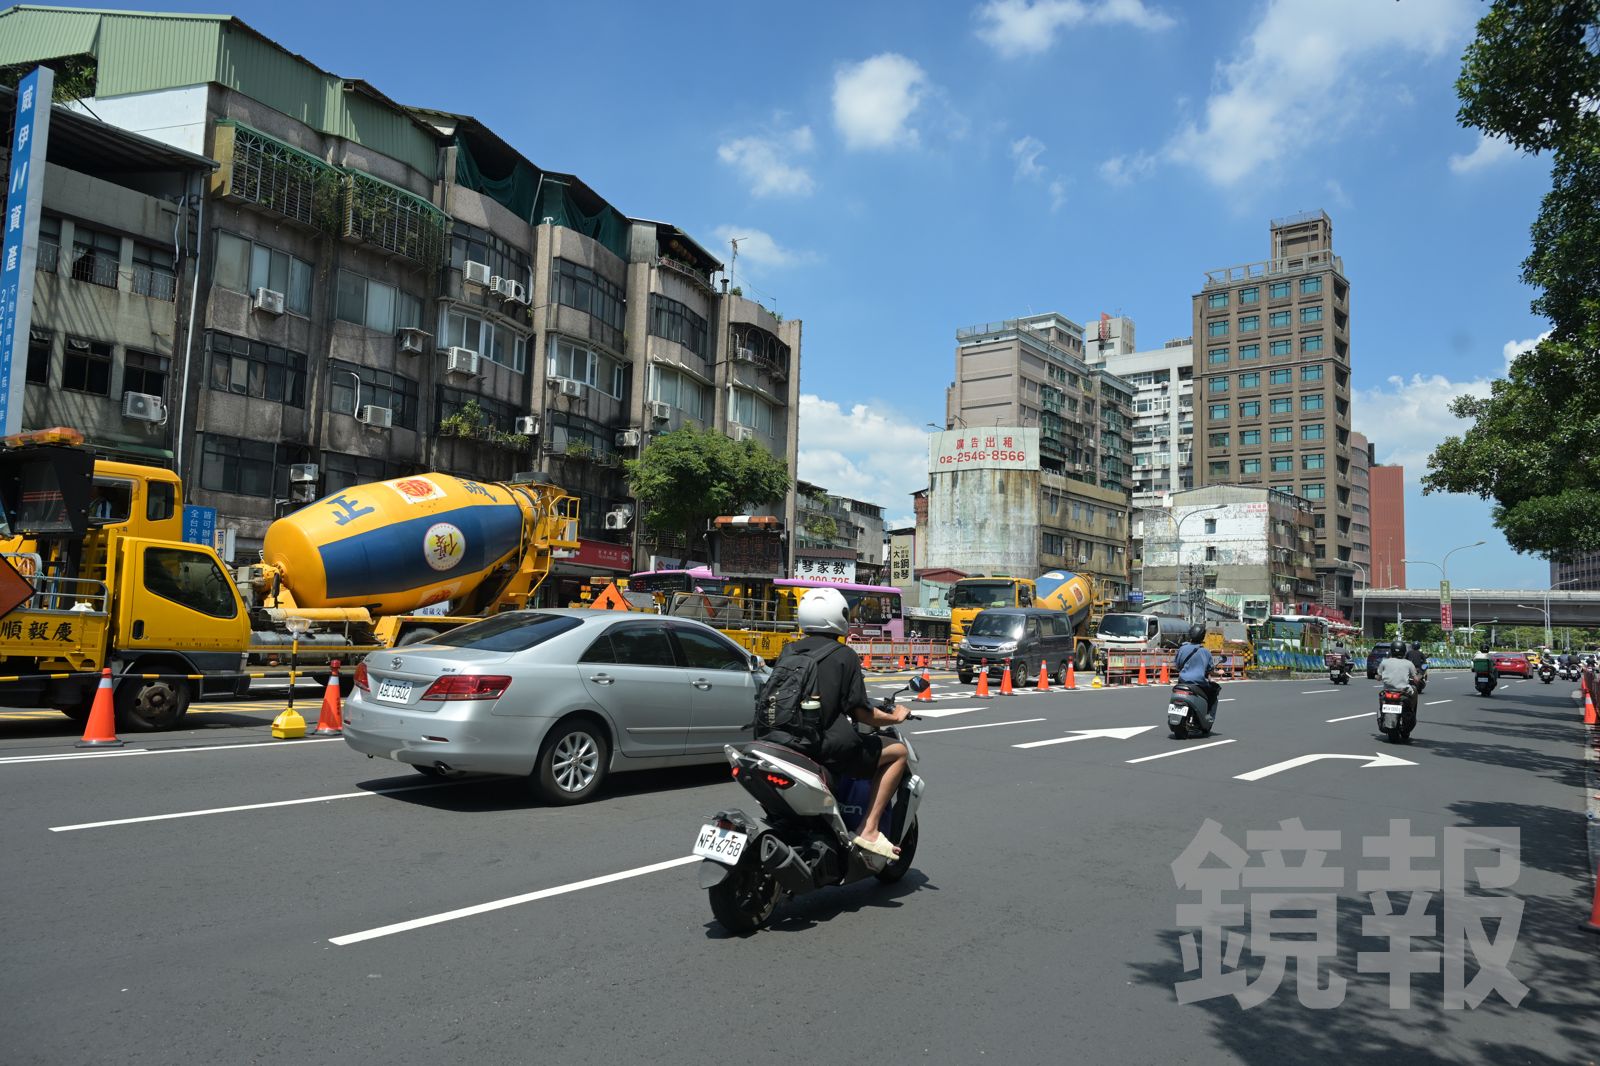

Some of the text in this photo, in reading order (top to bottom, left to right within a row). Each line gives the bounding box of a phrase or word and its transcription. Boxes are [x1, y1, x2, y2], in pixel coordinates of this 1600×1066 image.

[956, 436, 1013, 450] 廣告出租
[939, 450, 1025, 464] 02-2546-8566
[900, 558, 910, 580] 鋼琴
